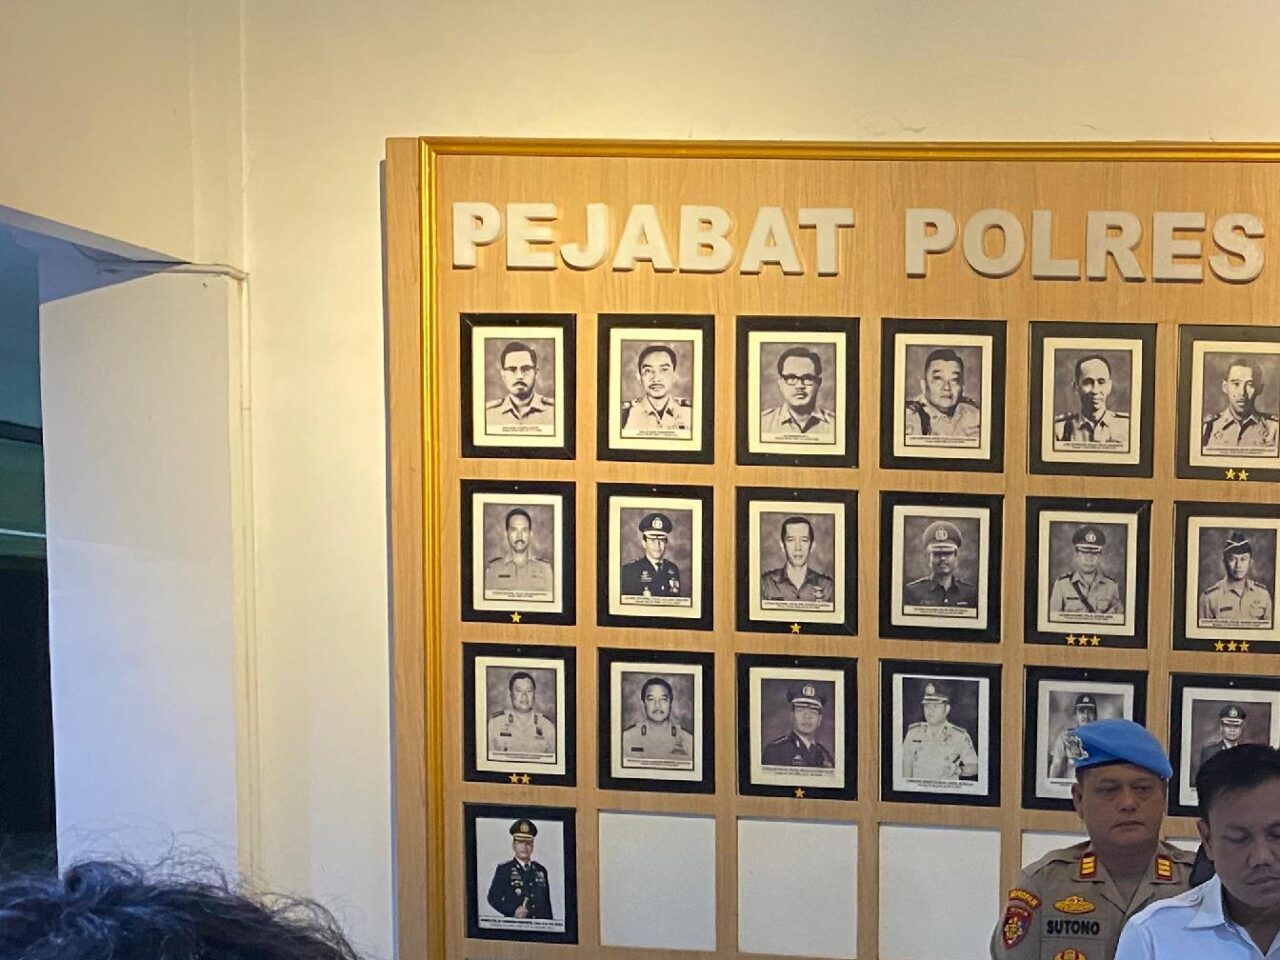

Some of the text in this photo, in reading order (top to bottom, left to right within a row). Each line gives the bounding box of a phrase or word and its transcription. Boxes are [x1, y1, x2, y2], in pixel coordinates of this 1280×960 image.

[452, 202, 854, 277] PEJABAT
[903, 208, 1266, 283] POLRES
[1046, 919, 1100, 936] SUTONO
